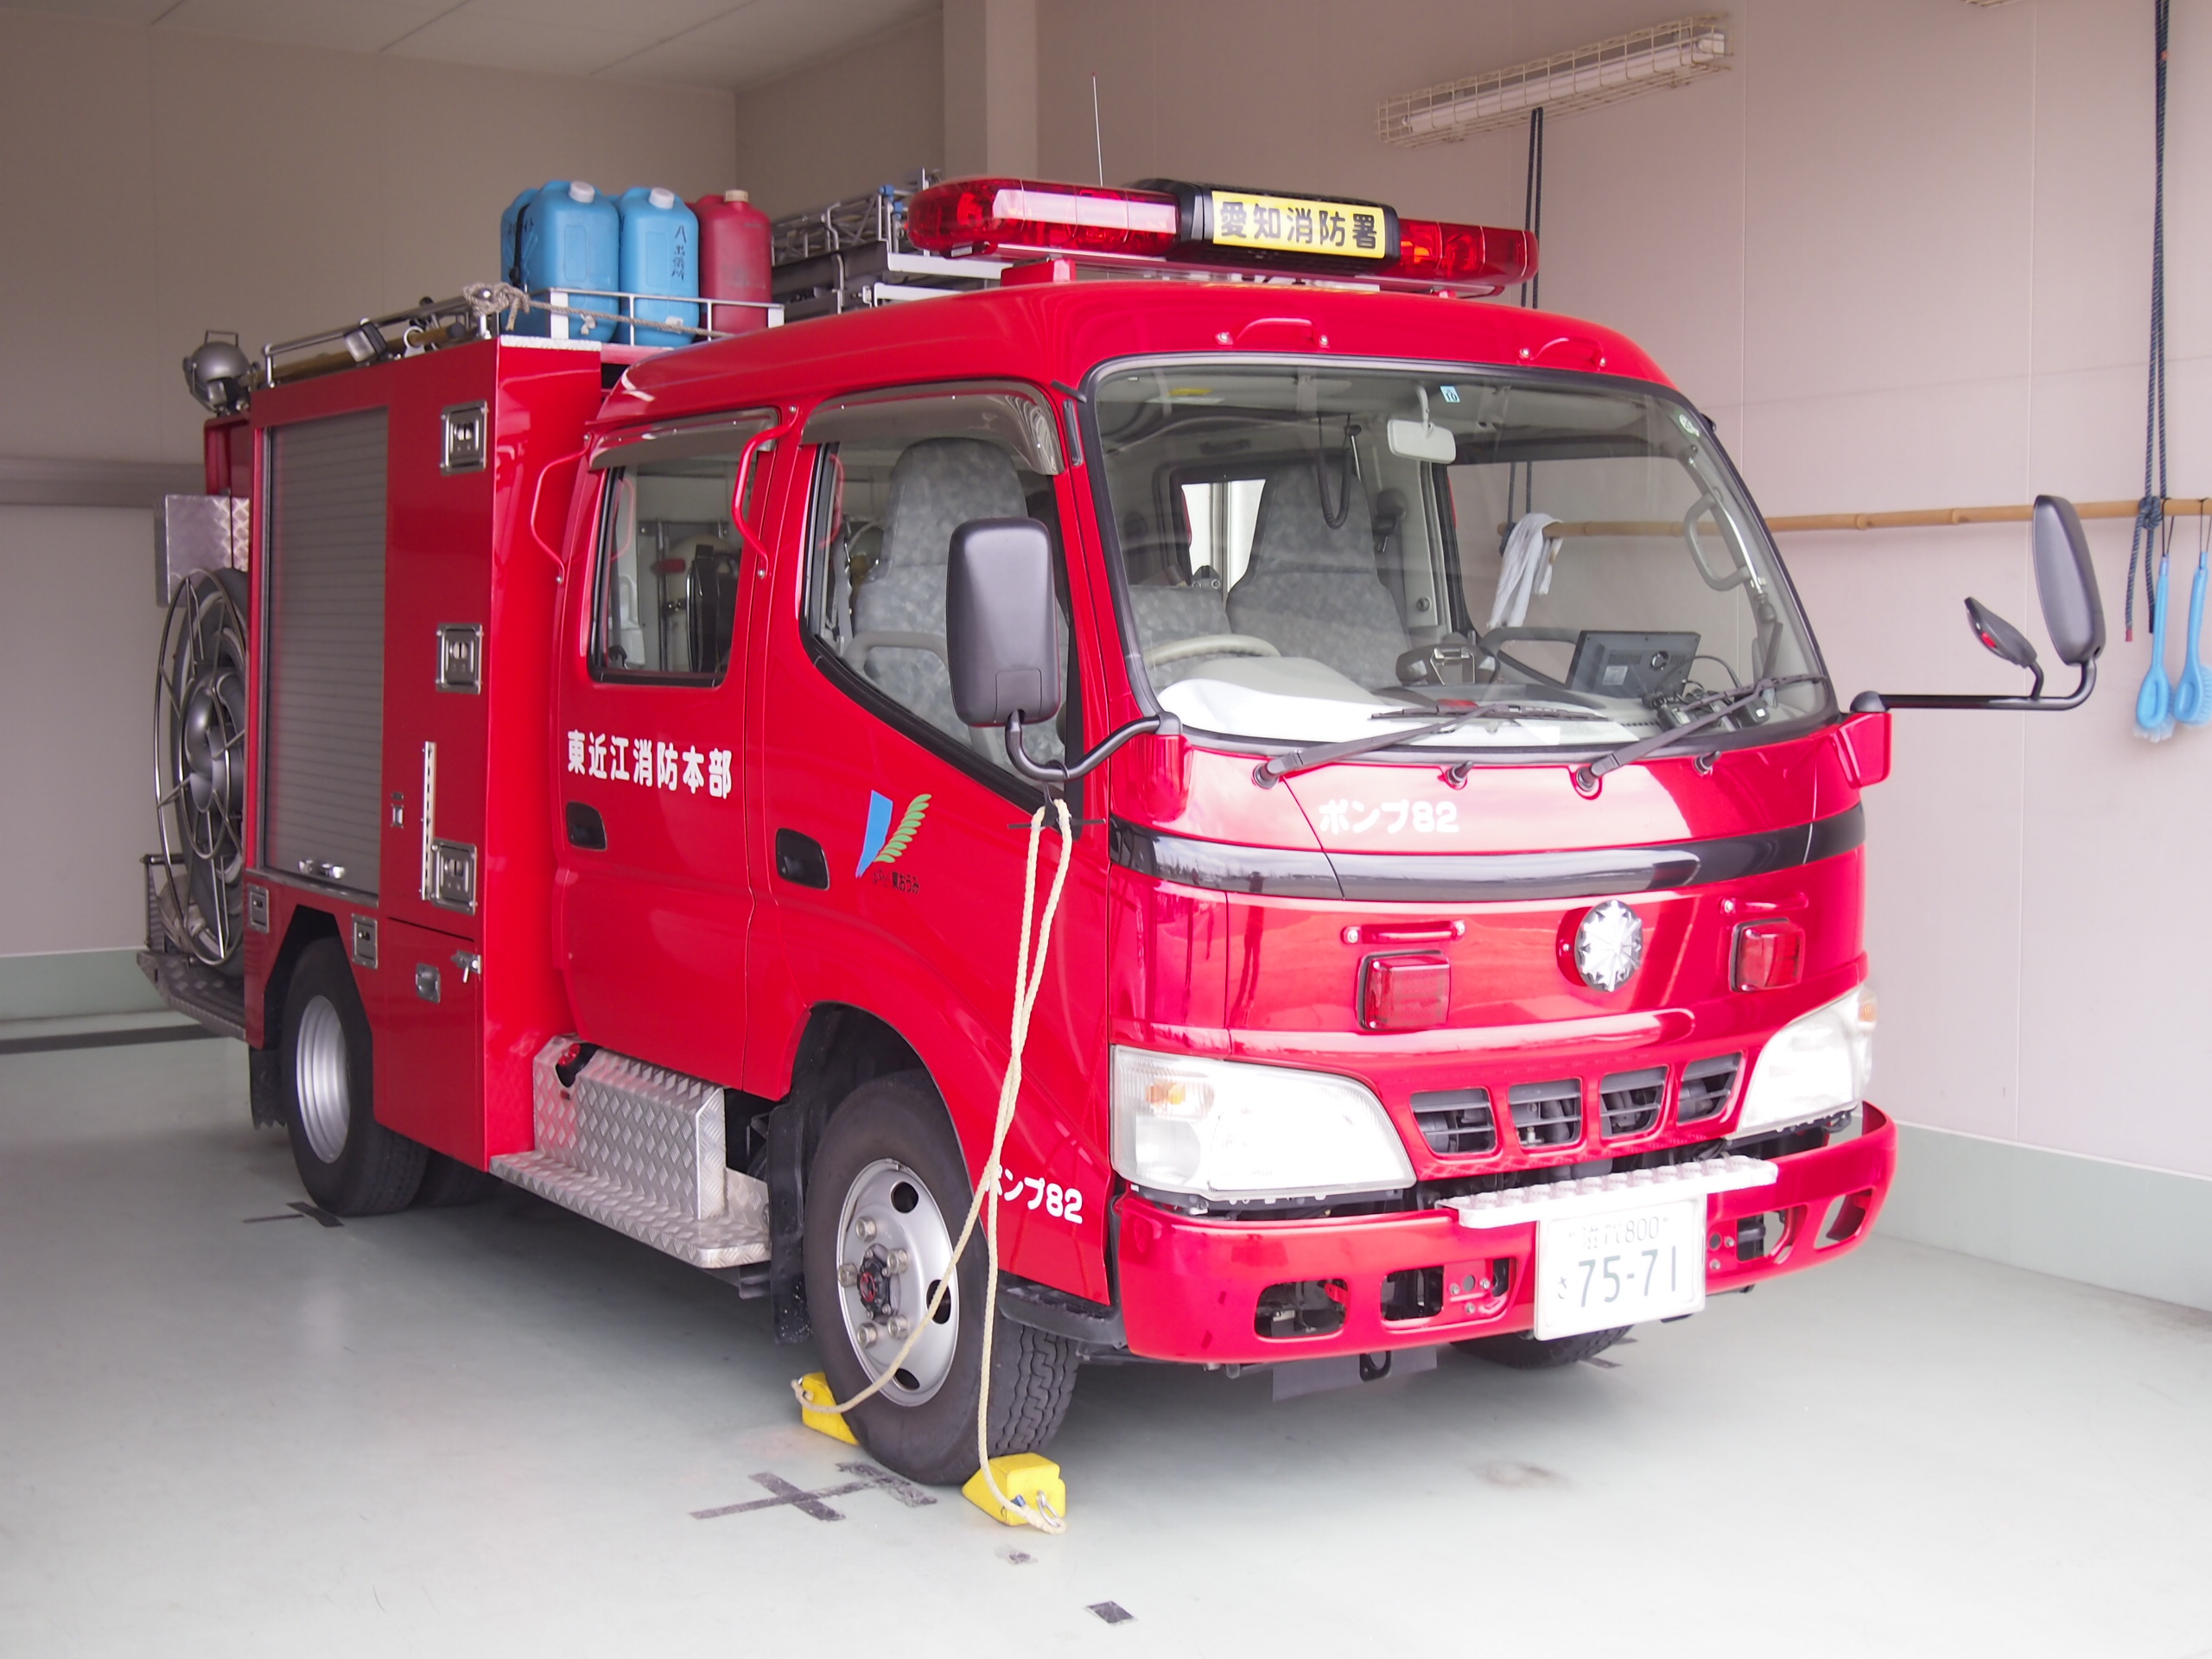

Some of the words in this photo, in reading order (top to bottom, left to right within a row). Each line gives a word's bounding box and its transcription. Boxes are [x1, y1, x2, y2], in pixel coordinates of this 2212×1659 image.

[1220, 201, 1377, 250] 愛知消防署
[567, 729, 733, 800] 東近江消防本部
[1319, 798, 1459, 835] ポンプ82
[1625, 1217, 1659, 1243] 800
[1578, 1245, 1676, 1308] 75-71
